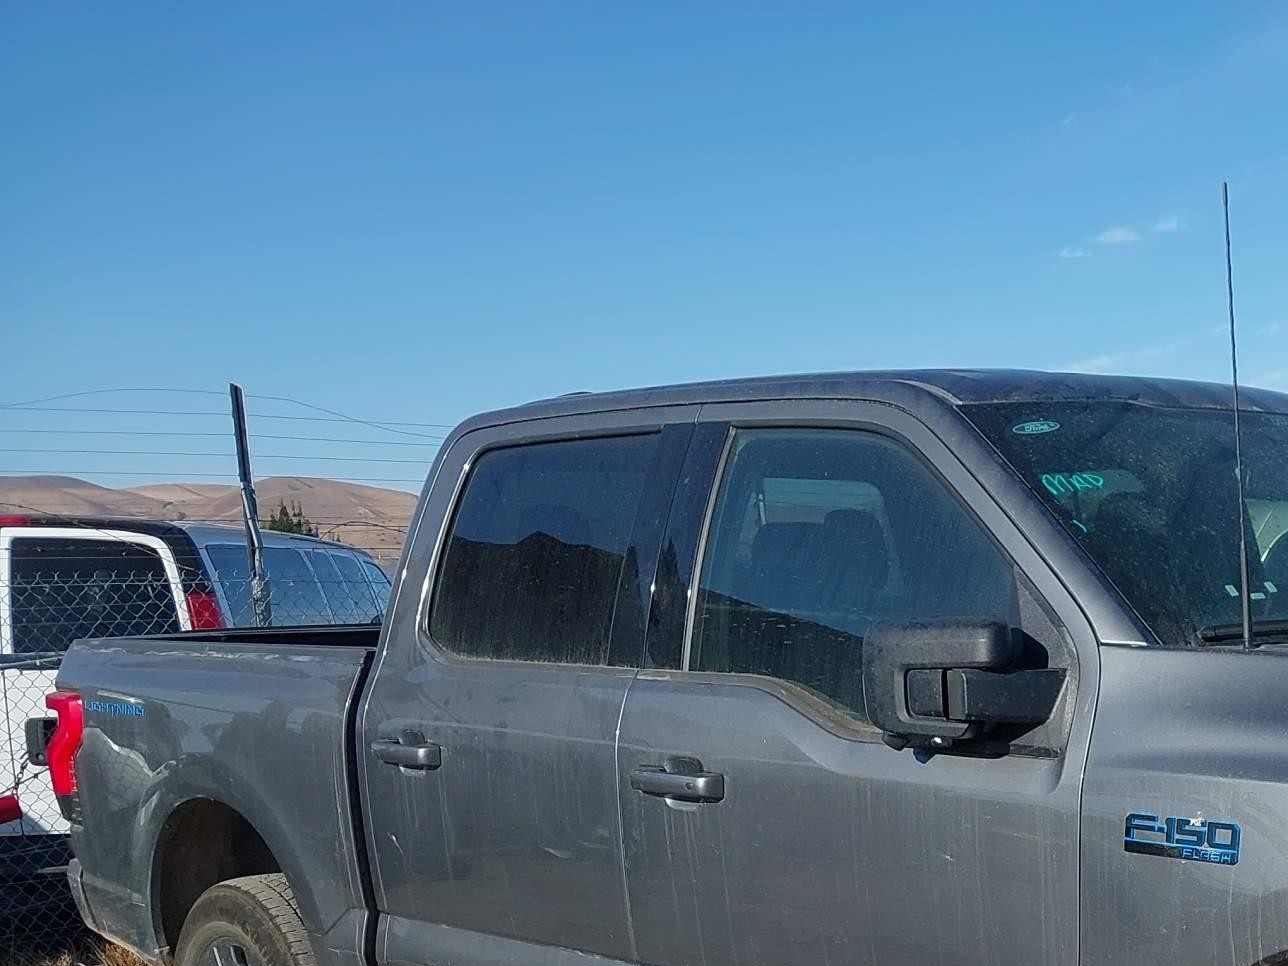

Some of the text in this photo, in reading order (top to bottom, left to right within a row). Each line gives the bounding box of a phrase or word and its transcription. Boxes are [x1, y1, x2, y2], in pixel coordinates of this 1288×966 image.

[84, 699, 144, 717] LIGHTNING
[1124, 812, 1241, 851] F-150
[1182, 847, 1232, 864] FLASH
